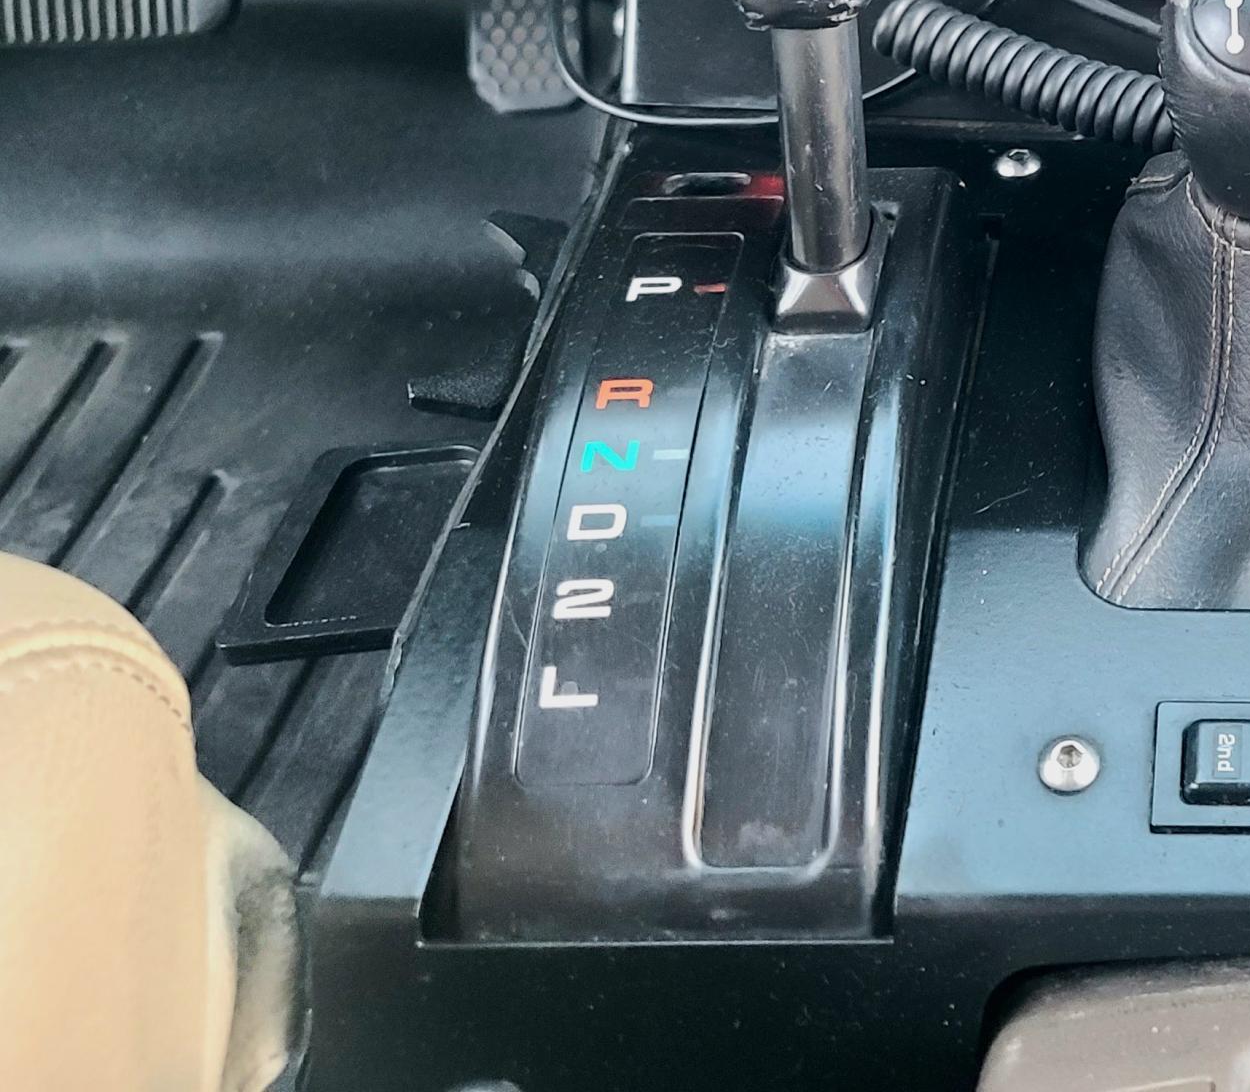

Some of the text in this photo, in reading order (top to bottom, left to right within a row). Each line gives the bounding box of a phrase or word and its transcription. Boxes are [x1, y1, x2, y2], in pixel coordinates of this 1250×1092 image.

[625, 276, 683, 302] P
[595, 378, 655, 410] R
[580, 439, 641, 473] N
[566, 503, 627, 541] D
[551, 578, 615, 620] 2
[538, 665, 599, 709] L
[1217, 733, 1236, 773] 2nd
